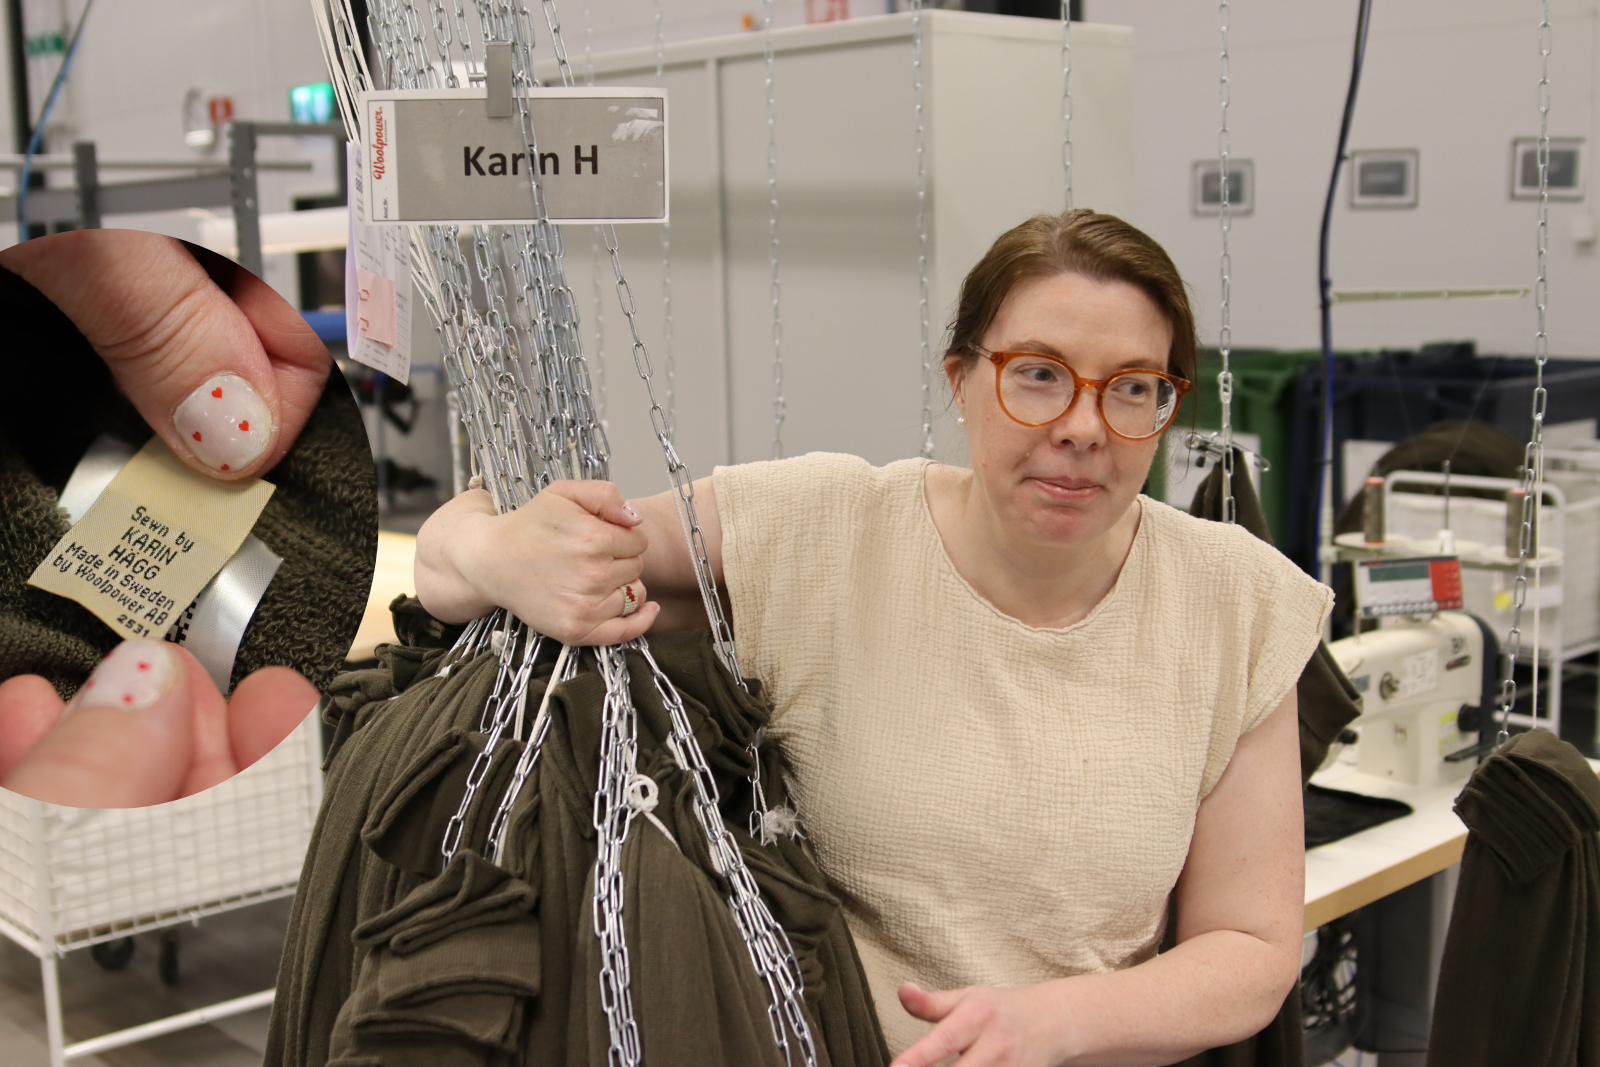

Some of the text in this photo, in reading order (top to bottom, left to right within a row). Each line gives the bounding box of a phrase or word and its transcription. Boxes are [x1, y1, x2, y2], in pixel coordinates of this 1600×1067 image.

[463, 144, 598, 176] Karin H
[120, 526, 178, 566] KARIN
[130, 505, 195, 553] Sewn by
[64, 541, 175, 611] Made in Sweden
[107, 544, 161, 580] HÄGG
[52, 553, 170, 626] by Woolpower AB
[117, 613, 151, 638] 2531
